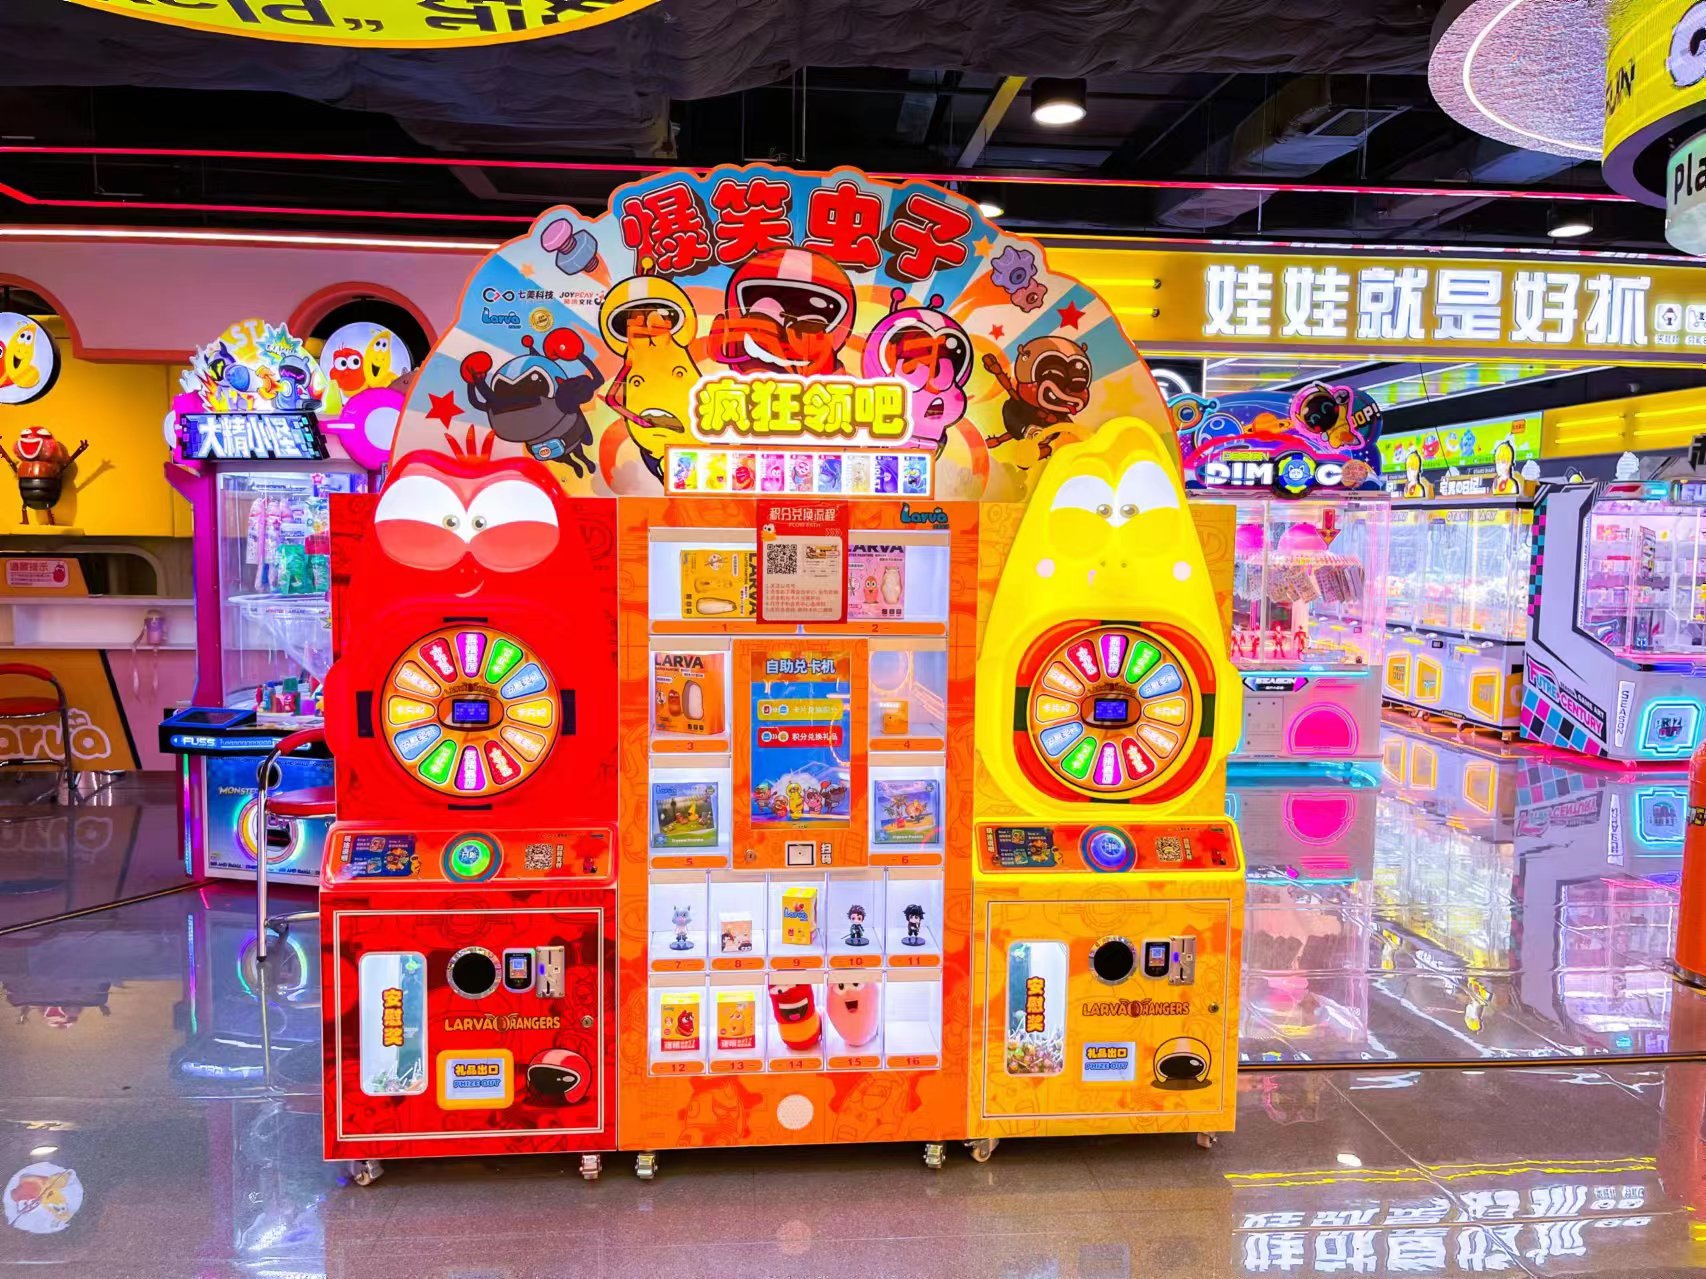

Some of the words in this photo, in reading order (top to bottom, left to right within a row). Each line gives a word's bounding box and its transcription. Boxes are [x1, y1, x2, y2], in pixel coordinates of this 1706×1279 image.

[620, 178, 973, 283] 爆笑虫子
[1204, 264, 1653, 346] 娃娃就是好抓
[698, 378, 907, 438] 疯狂领吧
[722, 623, 728, 632] 1
[872, 623, 879, 633] 2
[766, 659, 835, 674] 自助兑卡机
[1560, 691, 1604, 735] CENTURY
[1616, 690, 1631, 735] SEASON
[183, 736, 216, 747] FUSS
[687, 741, 695, 750] 3
[903, 740, 910, 749] 4
[686, 857, 694, 866] 5
[902, 855, 909, 864] 6
[675, 960, 682, 969] 7
[734, 960, 742, 968] 8
[793, 959, 800, 967] 9
[849, 957, 863, 966] 10
[908, 956, 921, 965] 11
[1082, 1002, 1128, 1017] LARVA
[1141, 1002, 1190, 1015] RANGERS
[444, 1016, 496, 1032] LARVA
[509, 1016, 561, 1030] RANGERS
[1086, 1047, 1128, 1060] 礼品出口
[789, 1060, 803, 1069] 14
[848, 1057, 862, 1066] 15
[907, 1056, 920, 1065] 16
[454, 1062, 500, 1077] 礼品出口
[671, 1063, 686, 1072] 12
[730, 1061, 744, 1070] 13
